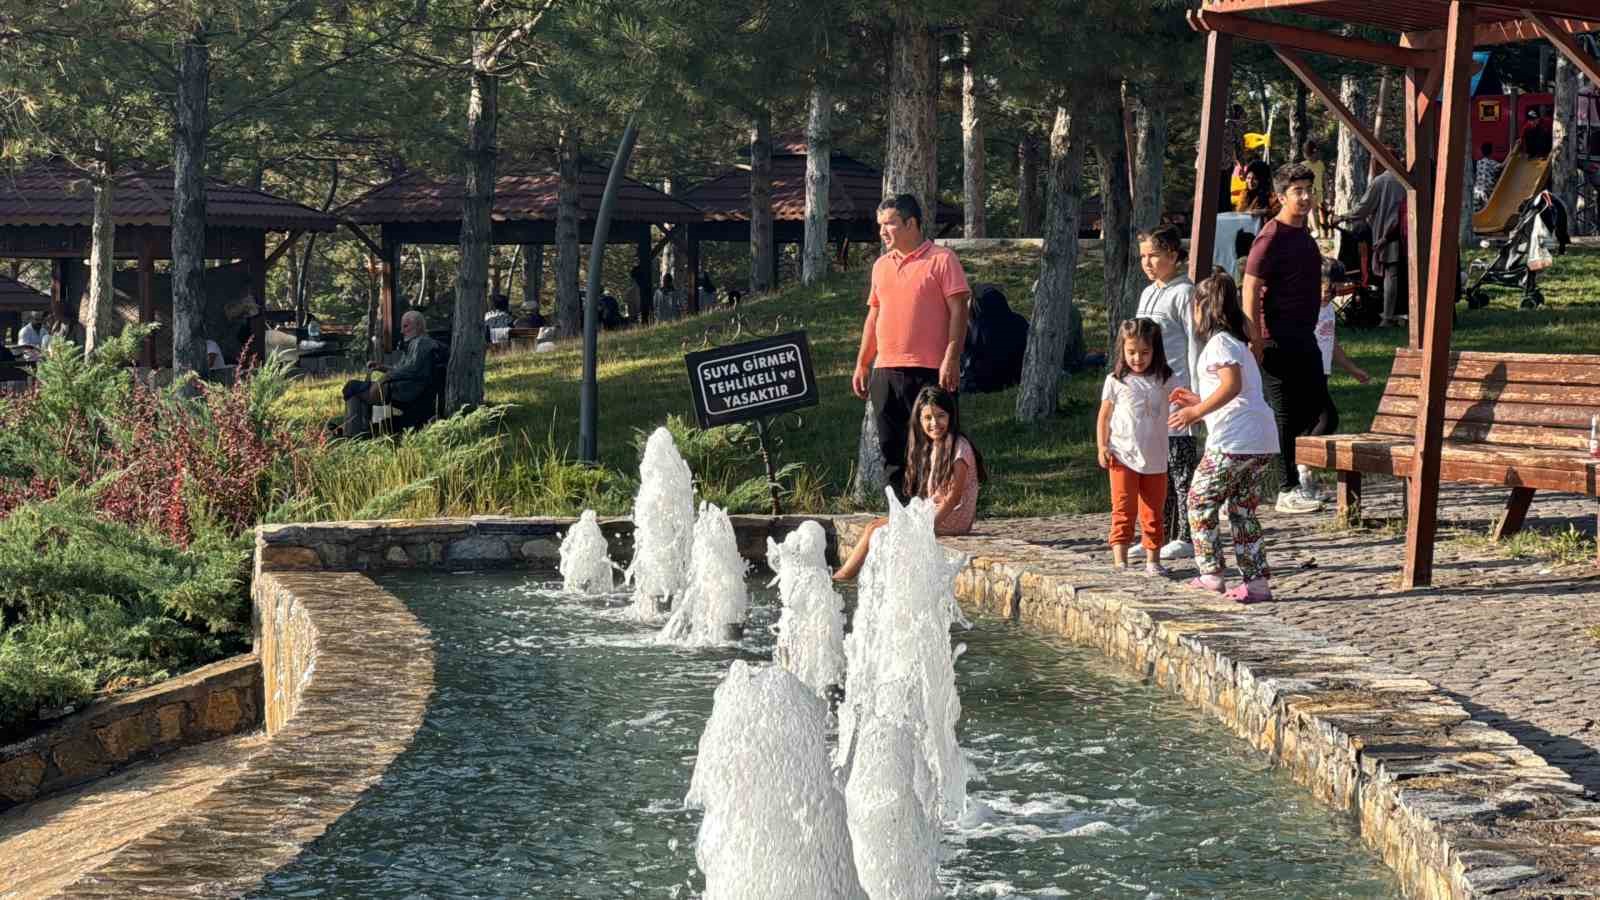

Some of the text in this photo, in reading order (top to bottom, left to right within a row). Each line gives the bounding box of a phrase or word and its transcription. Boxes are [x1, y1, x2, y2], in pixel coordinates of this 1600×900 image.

[703, 350, 797, 380] SUYA GİRMEK
[709, 368, 796, 395] TEHLİKELİ ve
[723, 384, 789, 408] YASAKTIR
